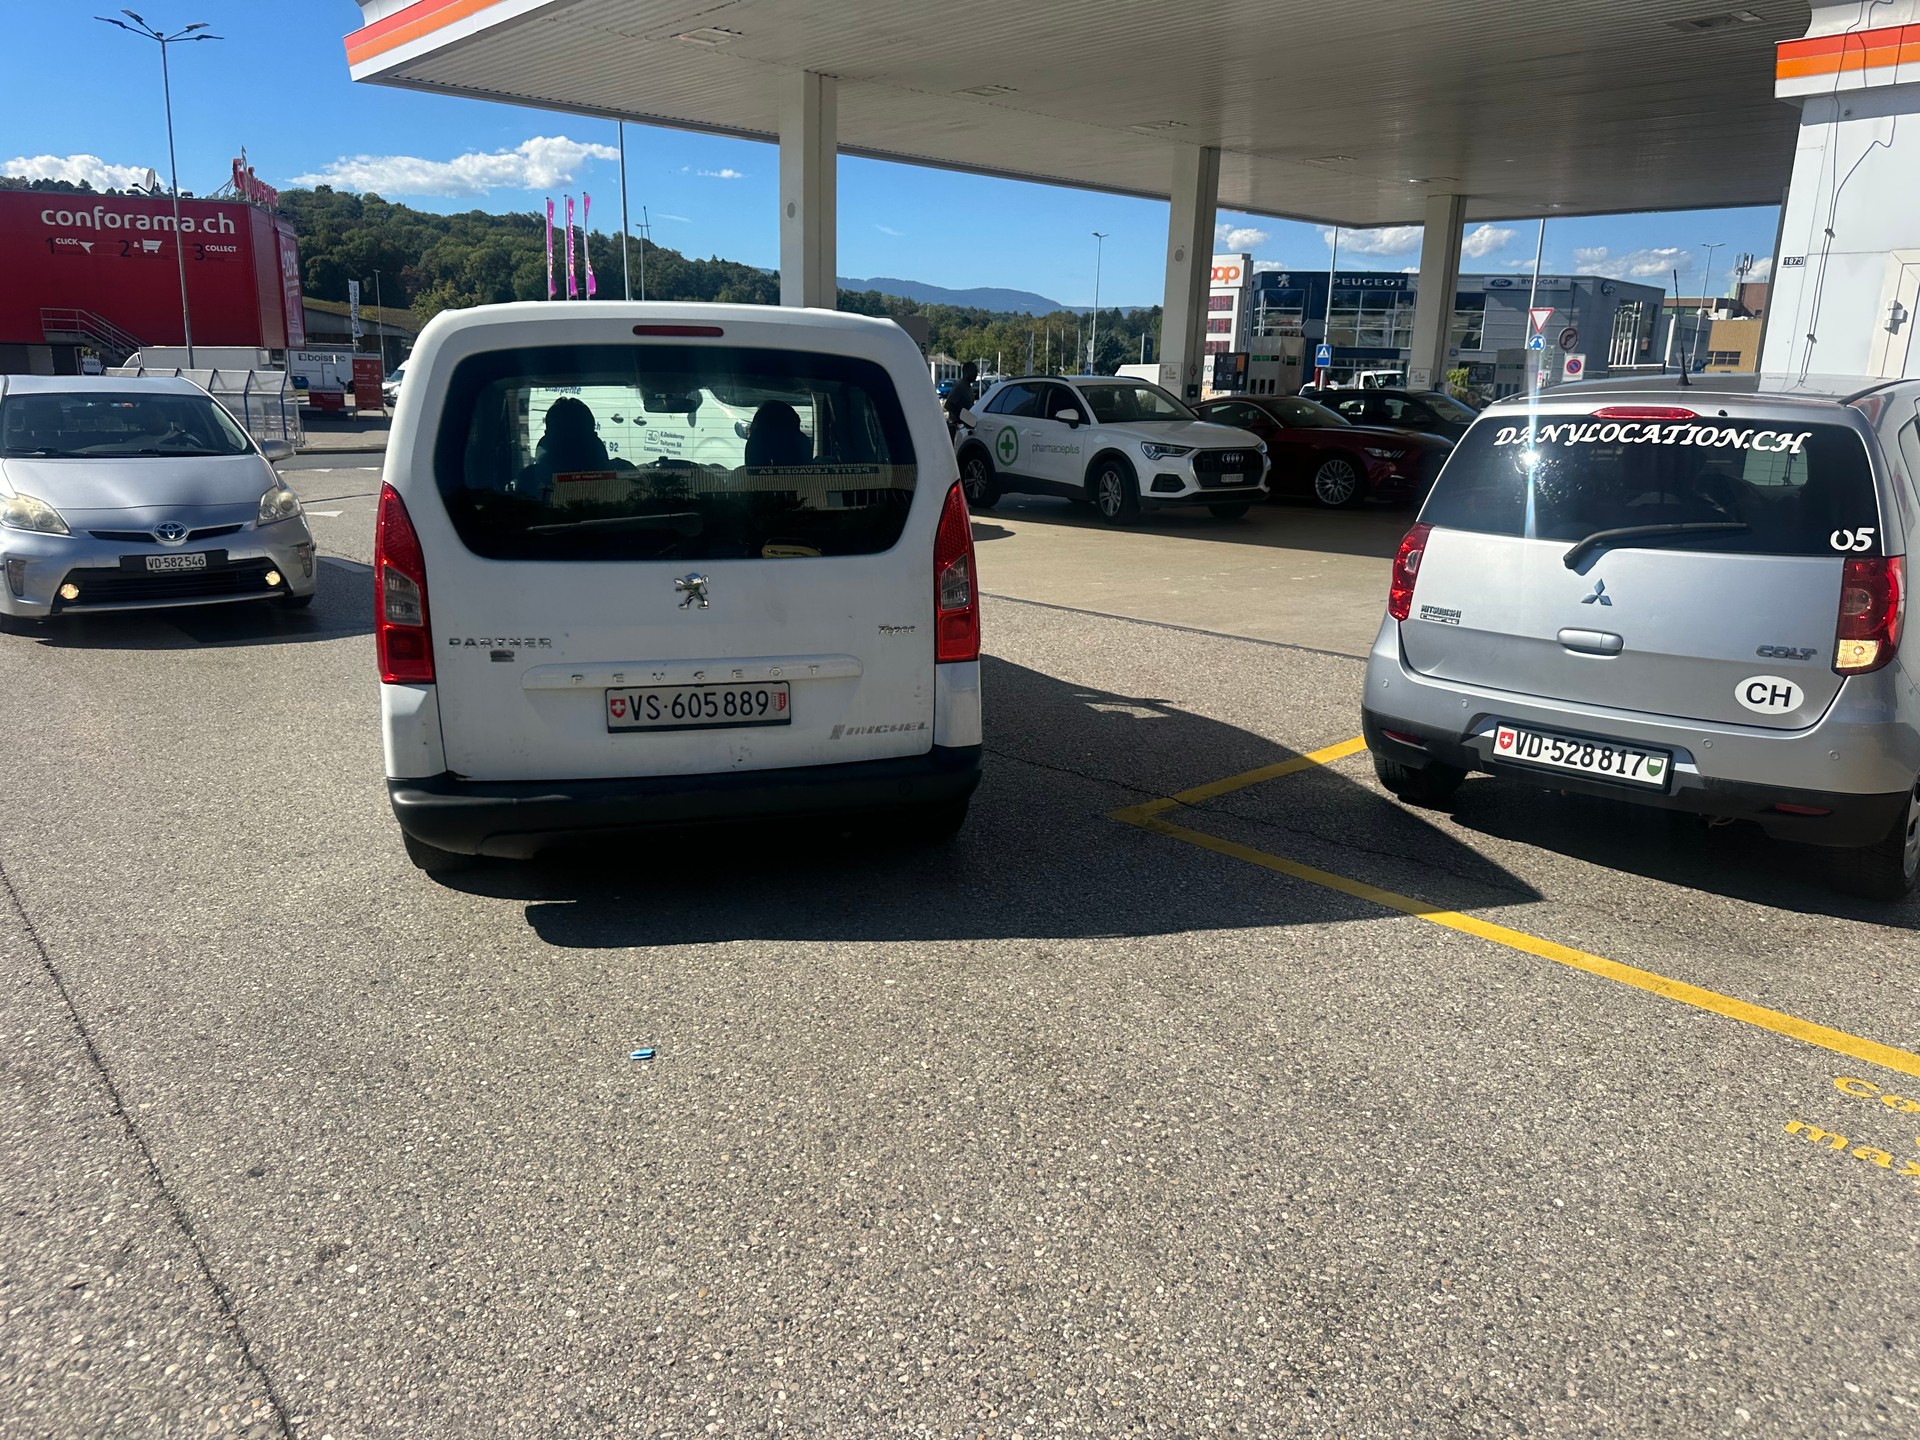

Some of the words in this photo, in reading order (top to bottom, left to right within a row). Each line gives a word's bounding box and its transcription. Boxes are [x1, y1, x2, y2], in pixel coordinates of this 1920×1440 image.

[41, 206, 235, 234] conforama.ch
[55, 237, 78, 246] CLICK
[205, 244, 237, 252] COLLECT
[1785, 257, 1803, 265] 1873
[1332, 277, 1405, 287] PEUGEOT
[1493, 424, 1813, 454] DANYLOCATION.CH
[1031, 442, 1080, 454] pharmacieplus
[878, 624, 916, 636] Tepee
[449, 637, 552, 648] PARTNER
[1756, 645, 1818, 661] COLT
[571, 664, 821, 685] PEUGEOT
[1745, 682, 1792, 708] CH
